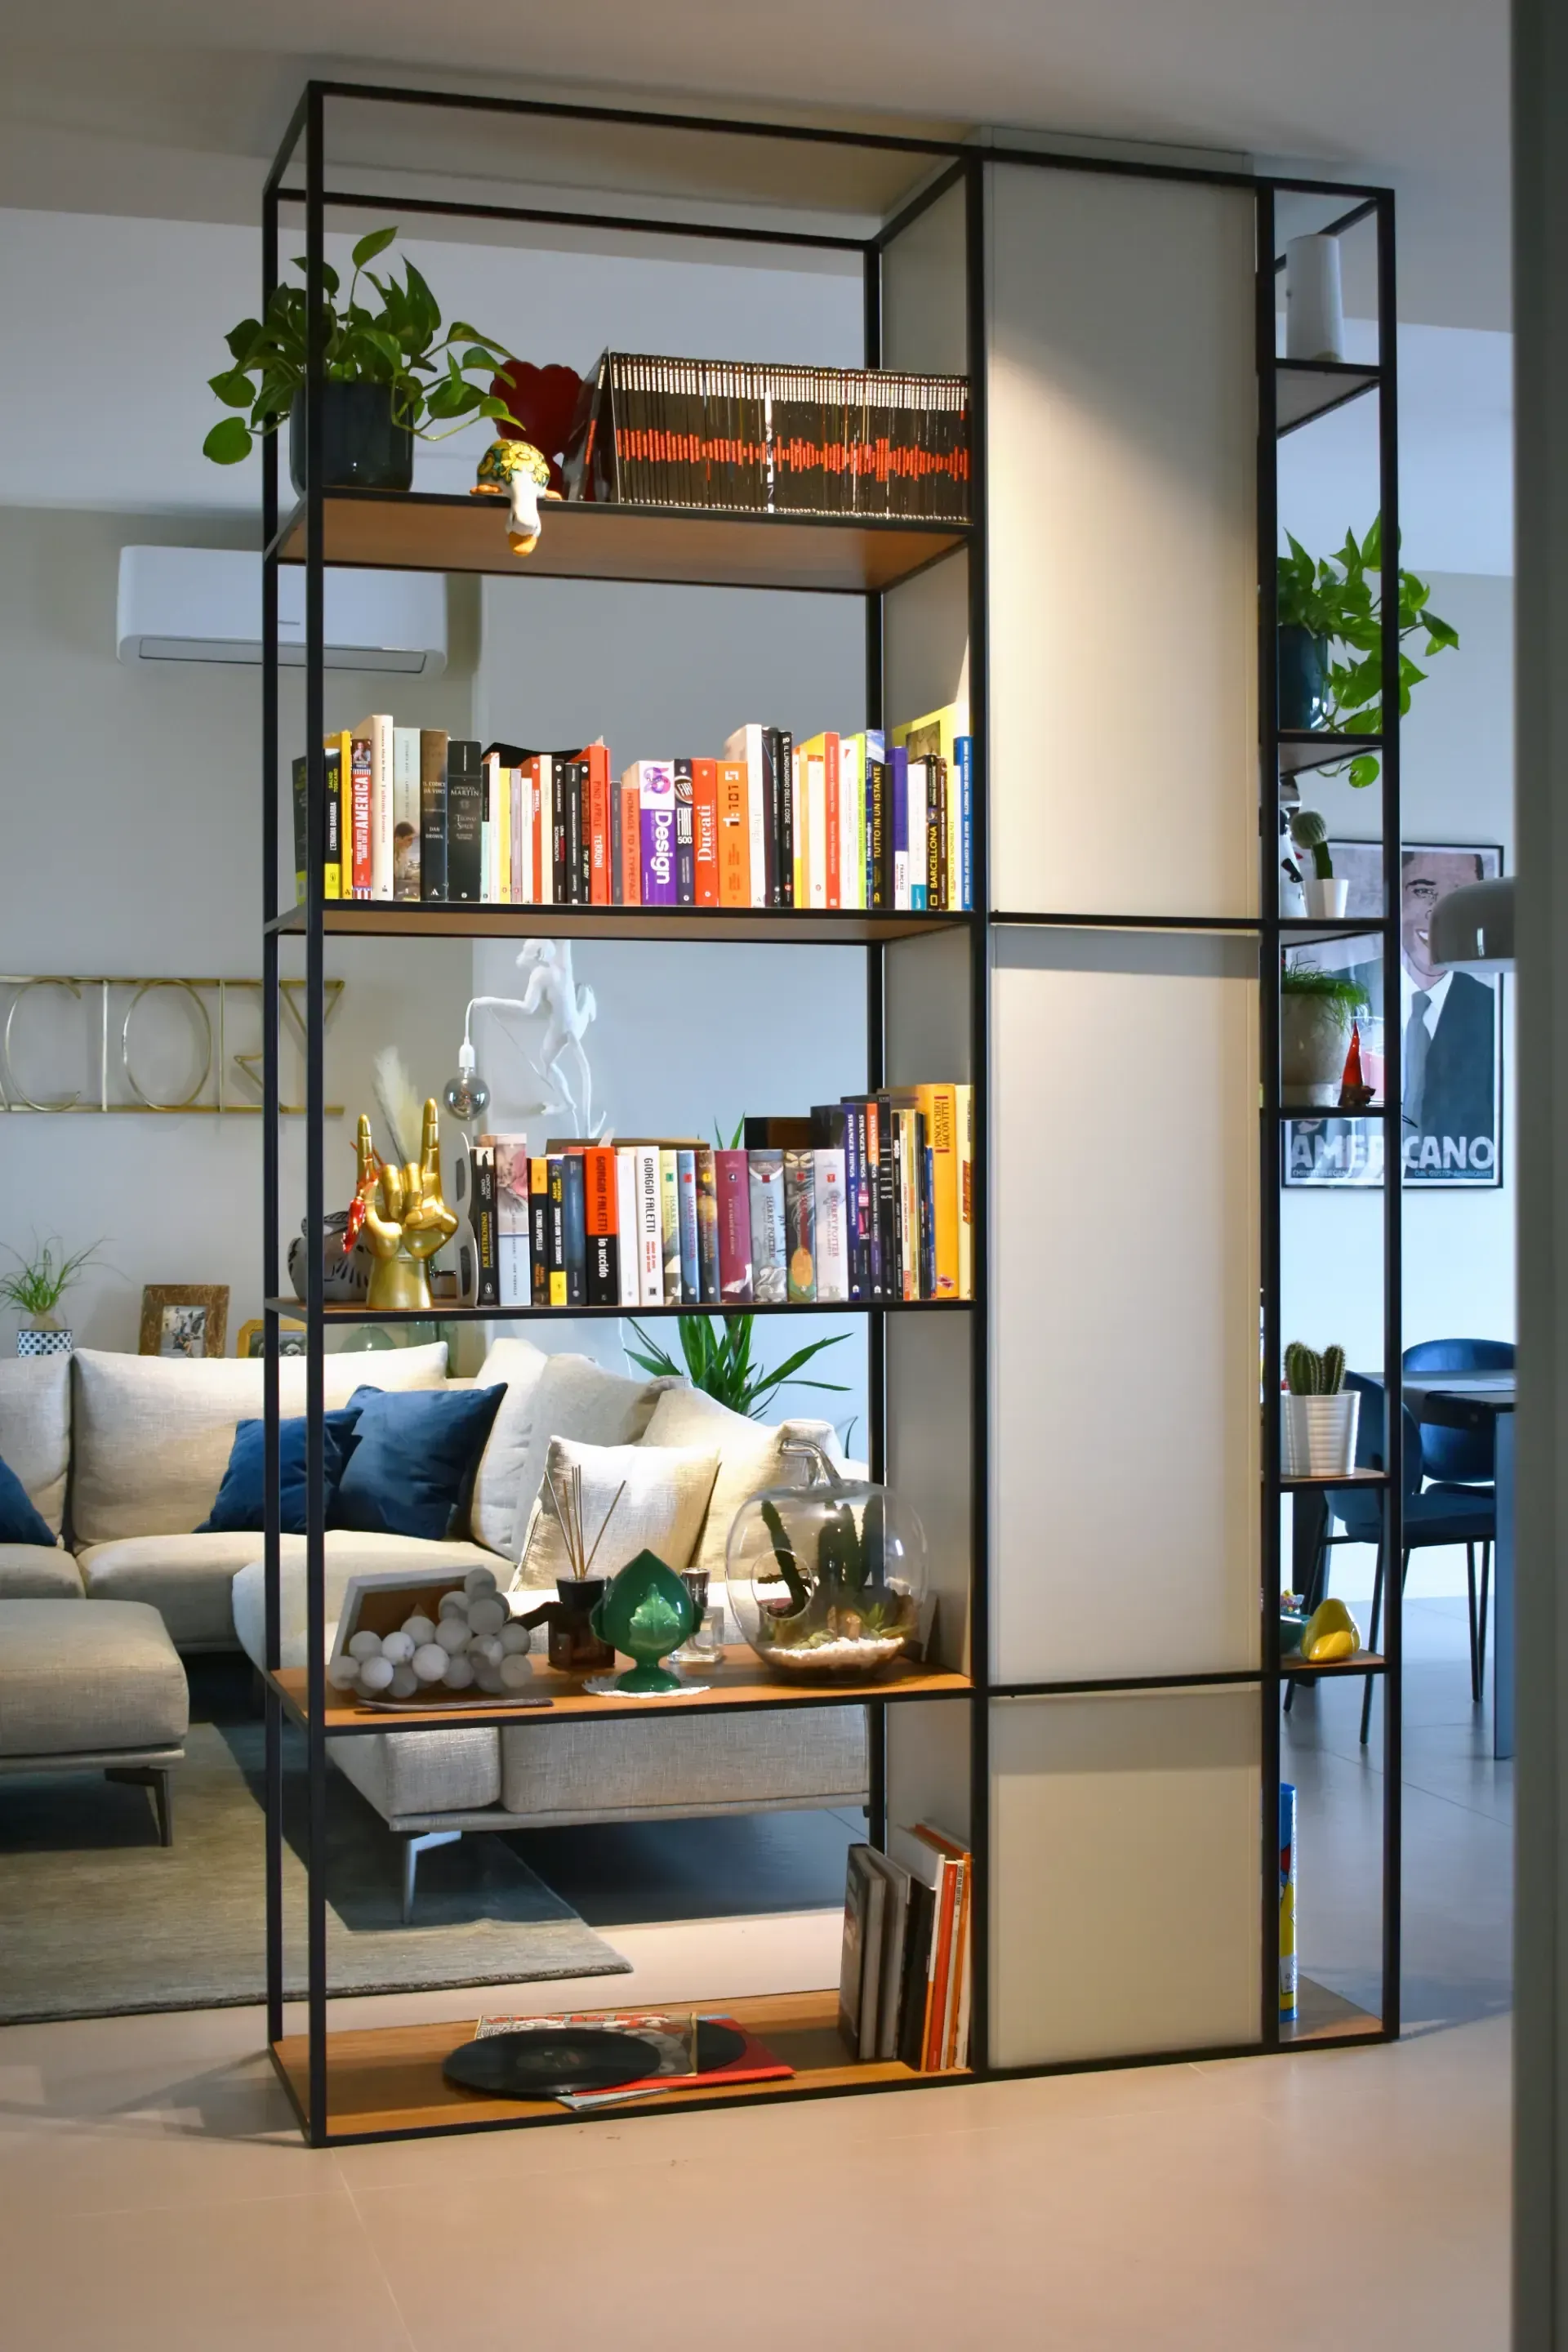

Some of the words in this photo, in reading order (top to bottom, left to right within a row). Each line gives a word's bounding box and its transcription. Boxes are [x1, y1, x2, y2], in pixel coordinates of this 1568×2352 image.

[450, 789, 479, 797] MARTIN
[873, 767, 881, 800] ISTANTE
[355, 777, 368, 828] AMERICA
[594, 803, 602, 827] APRILE
[873, 803, 881, 816] UN
[677, 808, 693, 835] FIAT
[697, 805, 711, 862] Ducati
[874, 818, 881, 827] IN
[594, 835, 603, 868] TERRONI
[627, 834, 635, 845] TO
[650, 811, 673, 884] Design
[678, 836, 693, 844] 500
[628, 857, 636, 900] TYPEFACE
[941, 1102, 950, 1147] JACOVITTI
[1291, 1134, 1495, 1169] AMERCANO
[596, 1156, 606, 1192] GIORGIO
[644, 1158, 654, 1194] GIORGIO
[535, 1209, 543, 1227] ULTIMO
[597, 1196, 608, 1232] FALETTI
[644, 1197, 656, 1232] FALETTI
[766, 1196, 774, 1224] HARRY
[535, 1229, 543, 1250] APPELLO
[598, 1238, 608, 1247] io
[768, 1227, 776, 1259] POTTER
[831, 1226, 840, 1258] POTTER
[598, 1250, 608, 1277] uccido
